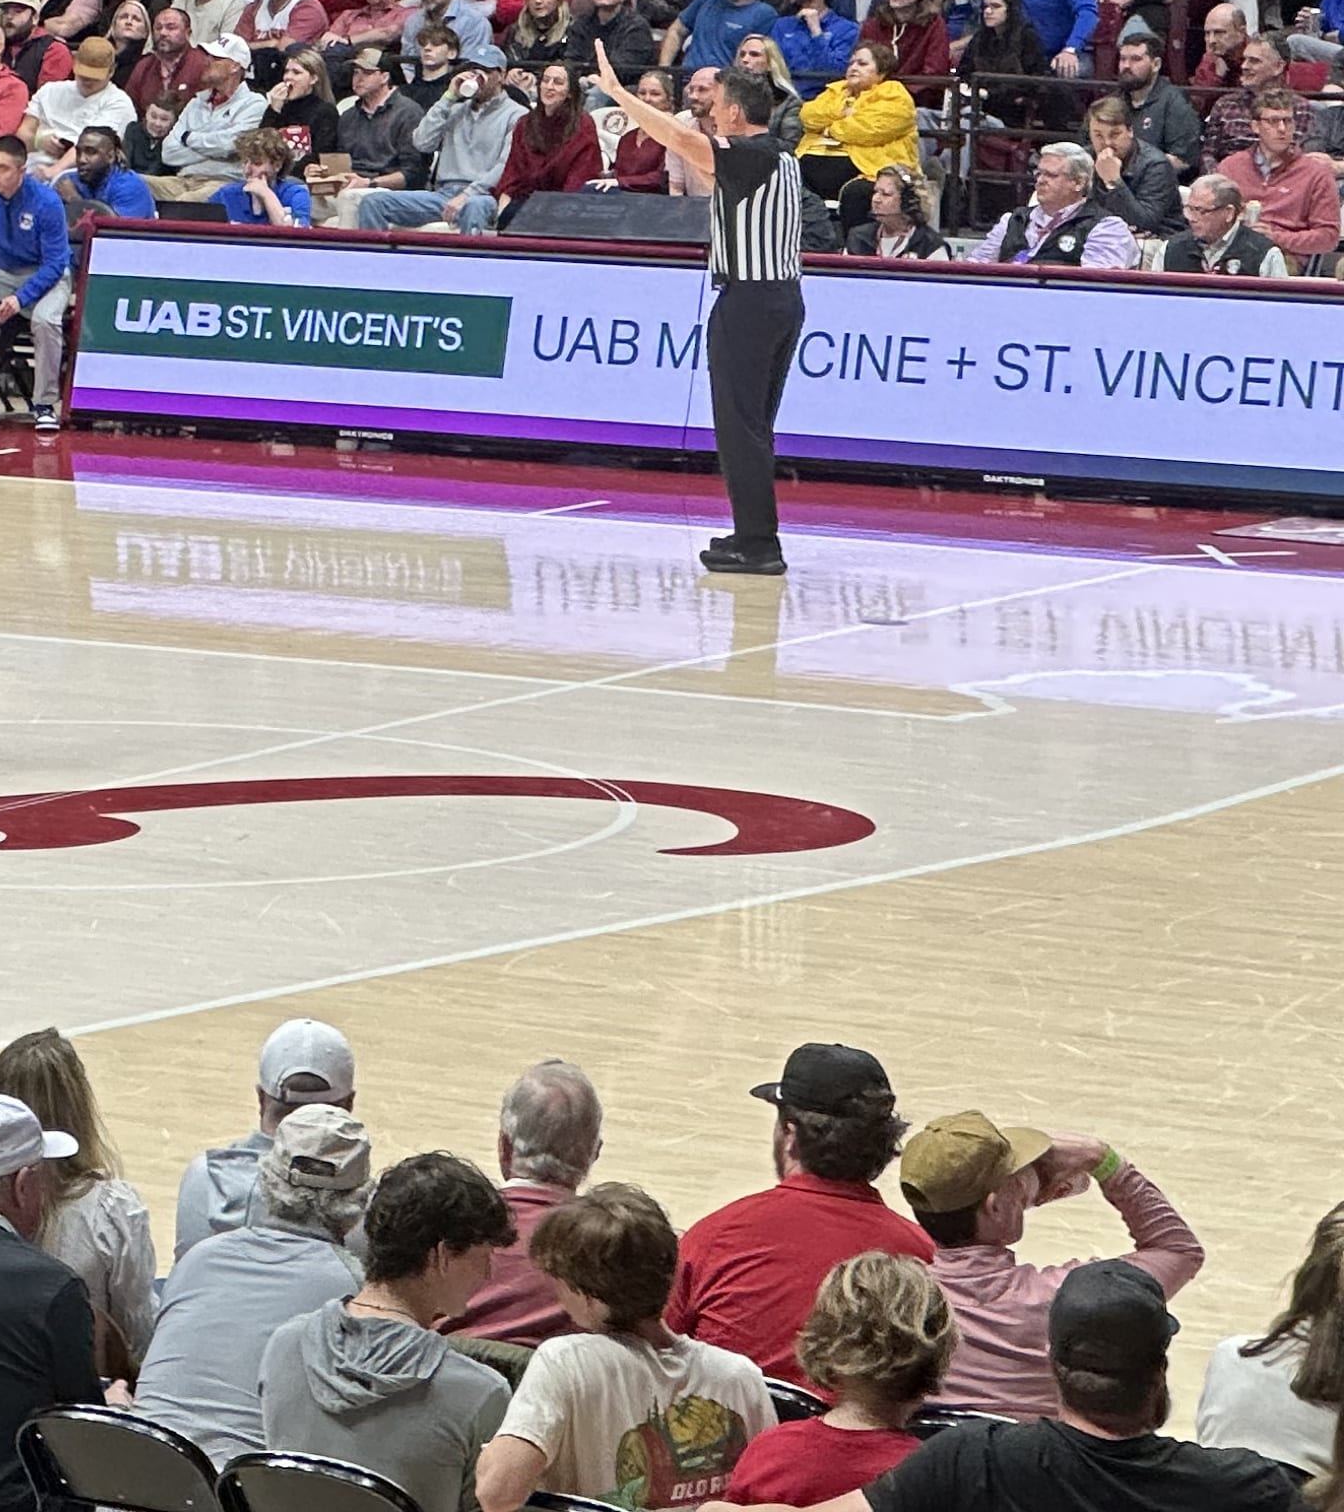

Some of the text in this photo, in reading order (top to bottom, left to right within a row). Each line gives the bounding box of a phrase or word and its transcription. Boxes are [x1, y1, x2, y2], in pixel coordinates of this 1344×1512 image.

[114, 297, 464, 352] UAB ST. VINCENT'S
[532, 314, 640, 367] UAB
[656, 321, 930, 385] MCINE
[993, 342, 1070, 393] ST.
[983, 474, 1045, 486] DAKTRONICS
